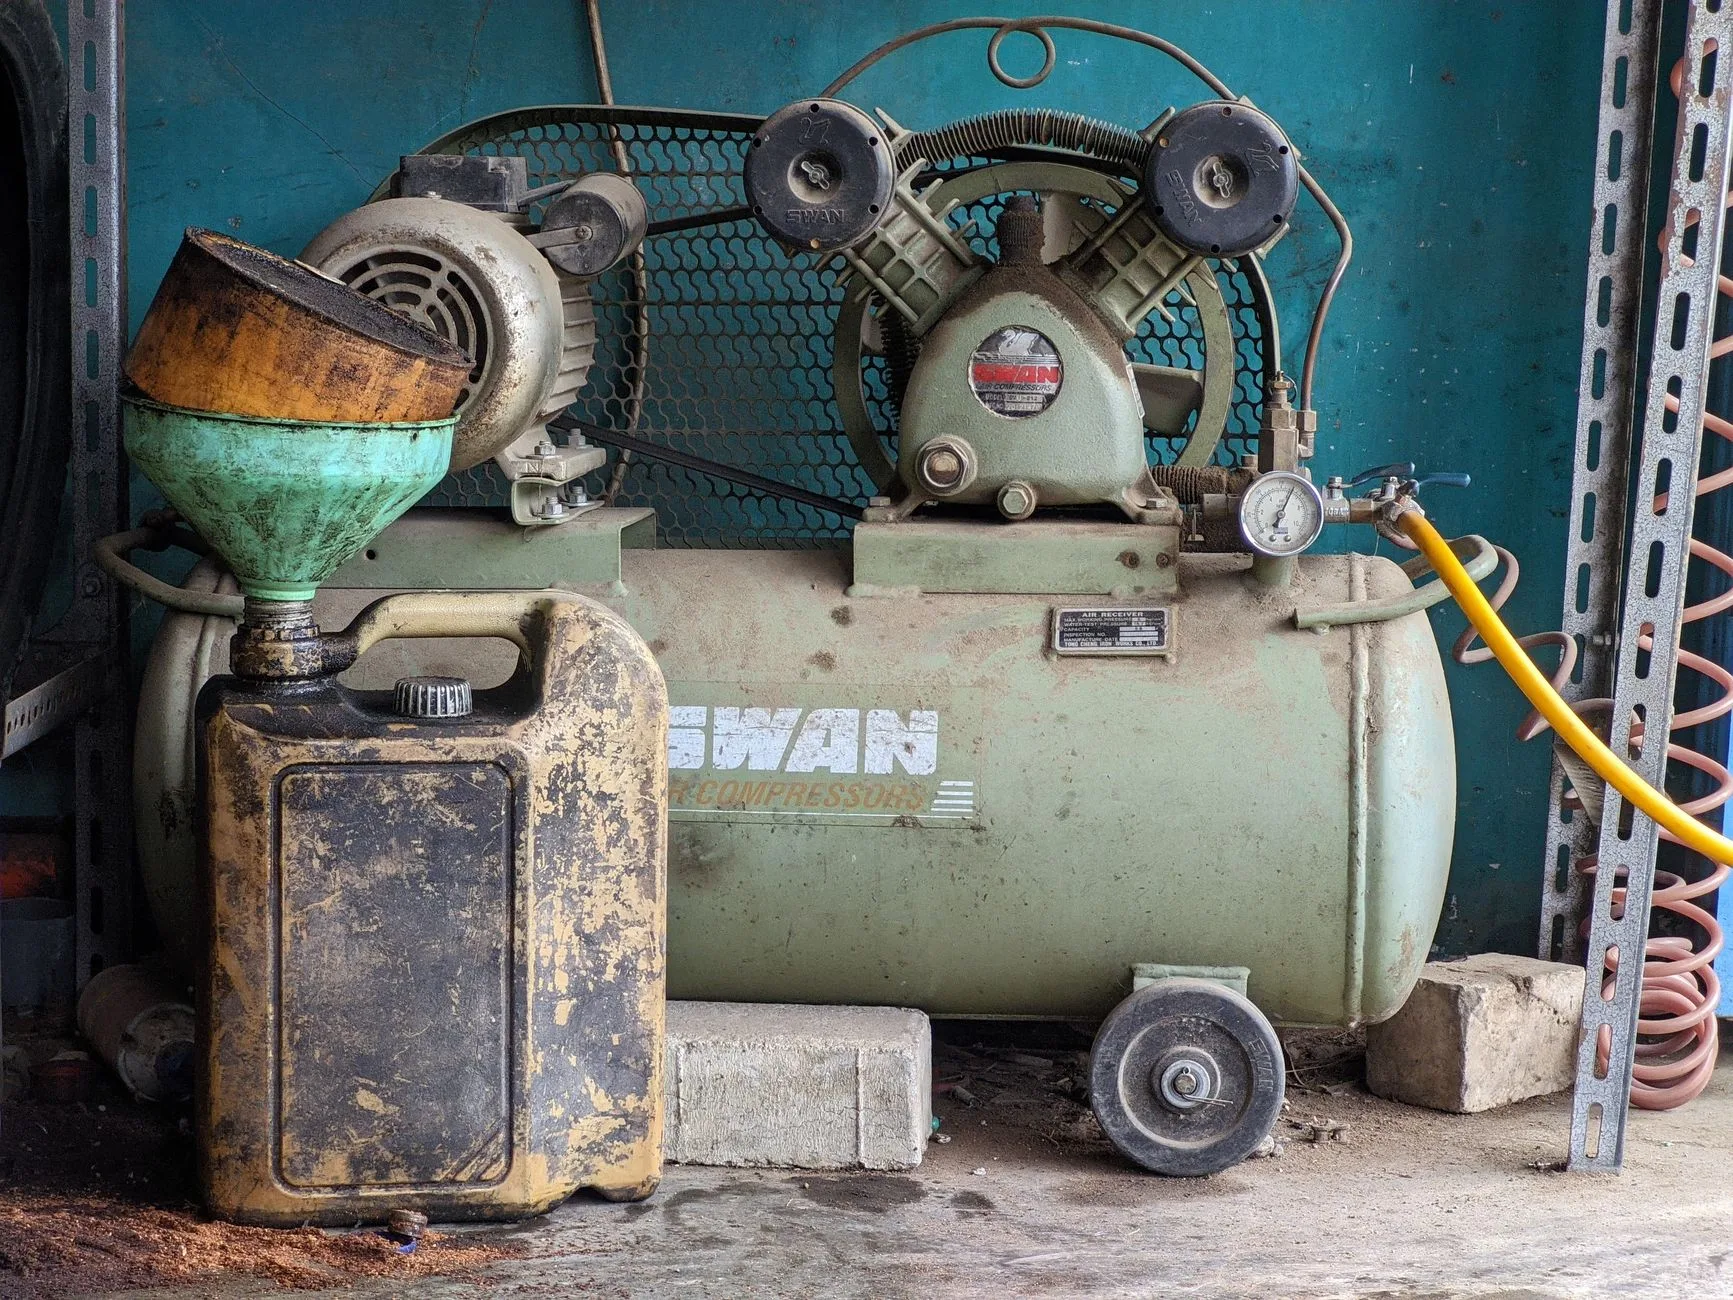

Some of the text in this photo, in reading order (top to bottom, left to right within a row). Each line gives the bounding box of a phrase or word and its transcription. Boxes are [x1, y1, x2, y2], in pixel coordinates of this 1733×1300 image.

[786, 209, 845, 224] SWAN
[993, 383, 1052, 392] COMPRESSORS
[668, 706, 938, 775] SWAN
[696, 780, 924, 811] COMPRESSORS
